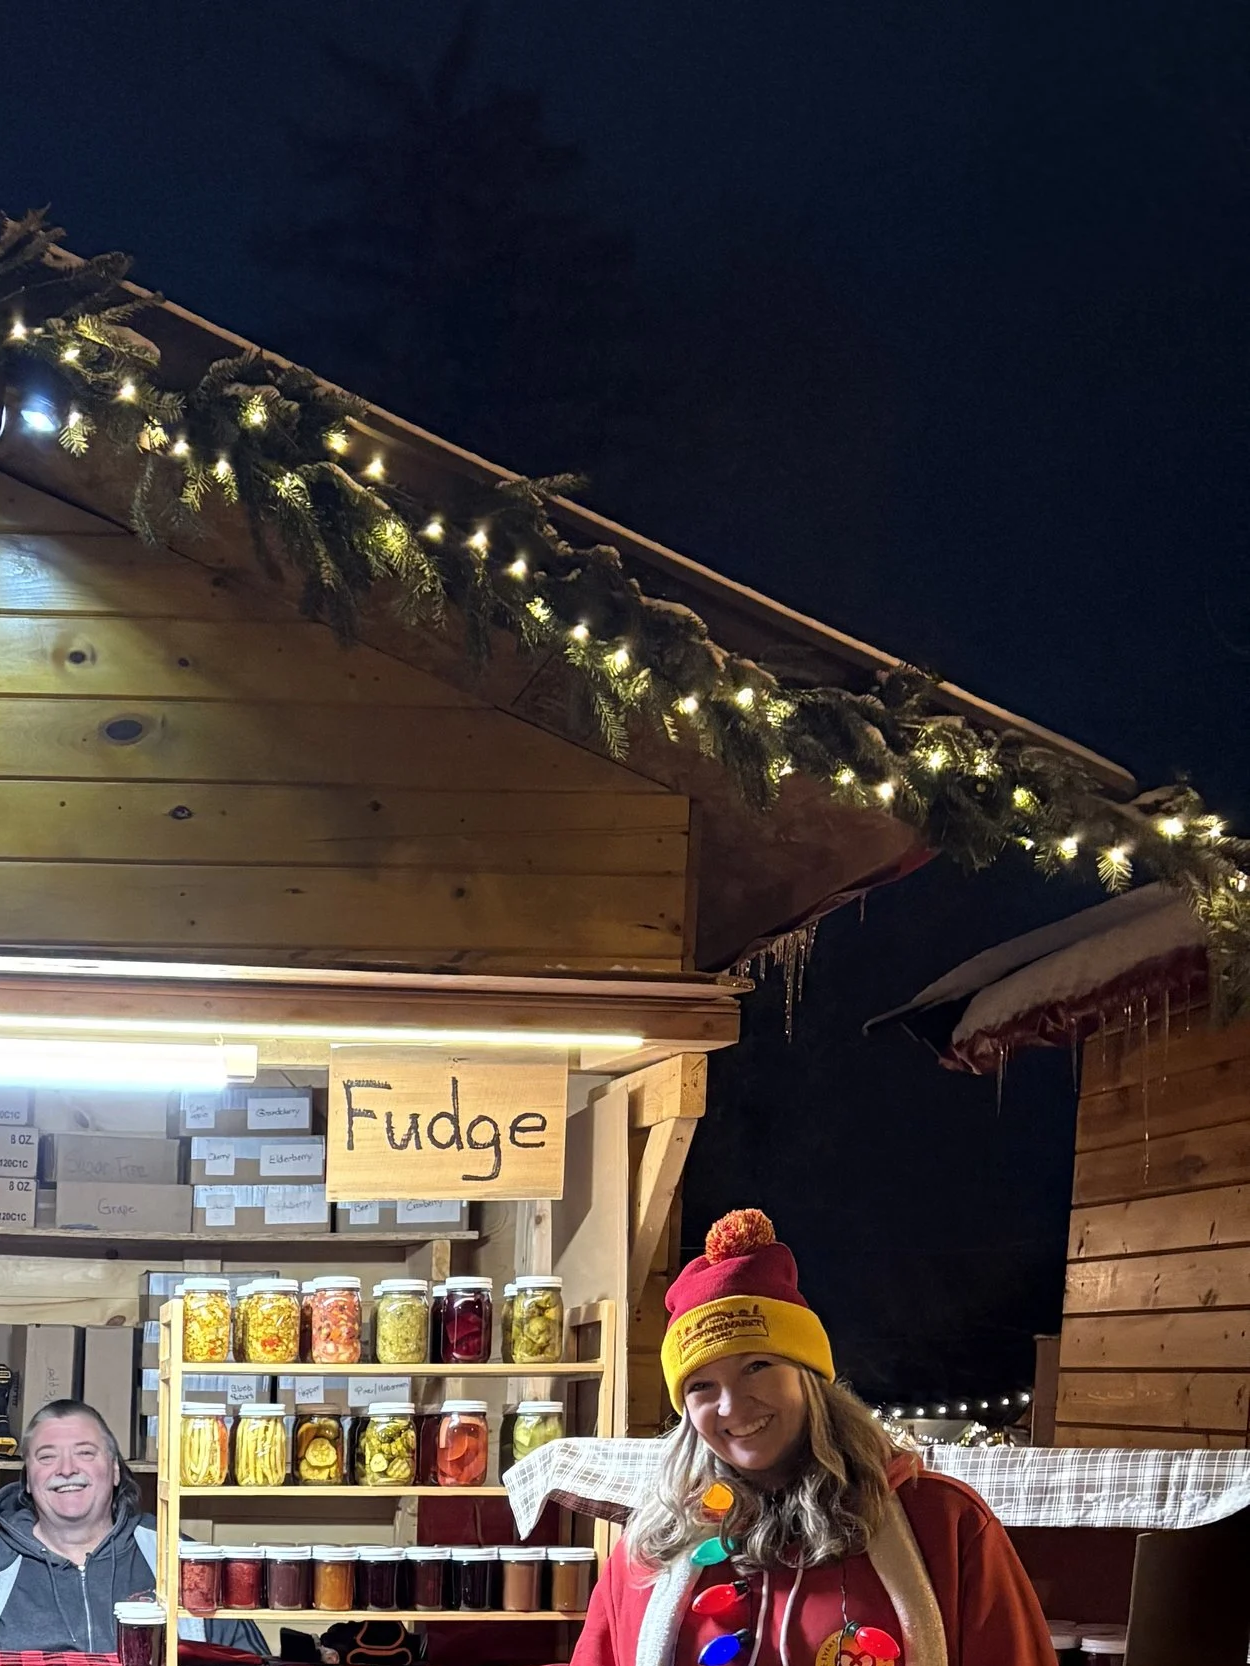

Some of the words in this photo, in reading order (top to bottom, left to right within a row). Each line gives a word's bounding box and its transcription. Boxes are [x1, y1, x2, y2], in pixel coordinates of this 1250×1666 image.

[343, 1076, 547, 1182] Fudge
[269, 1152, 313, 1164] Elderberry
[97, 1198, 137, 1216] Grape
